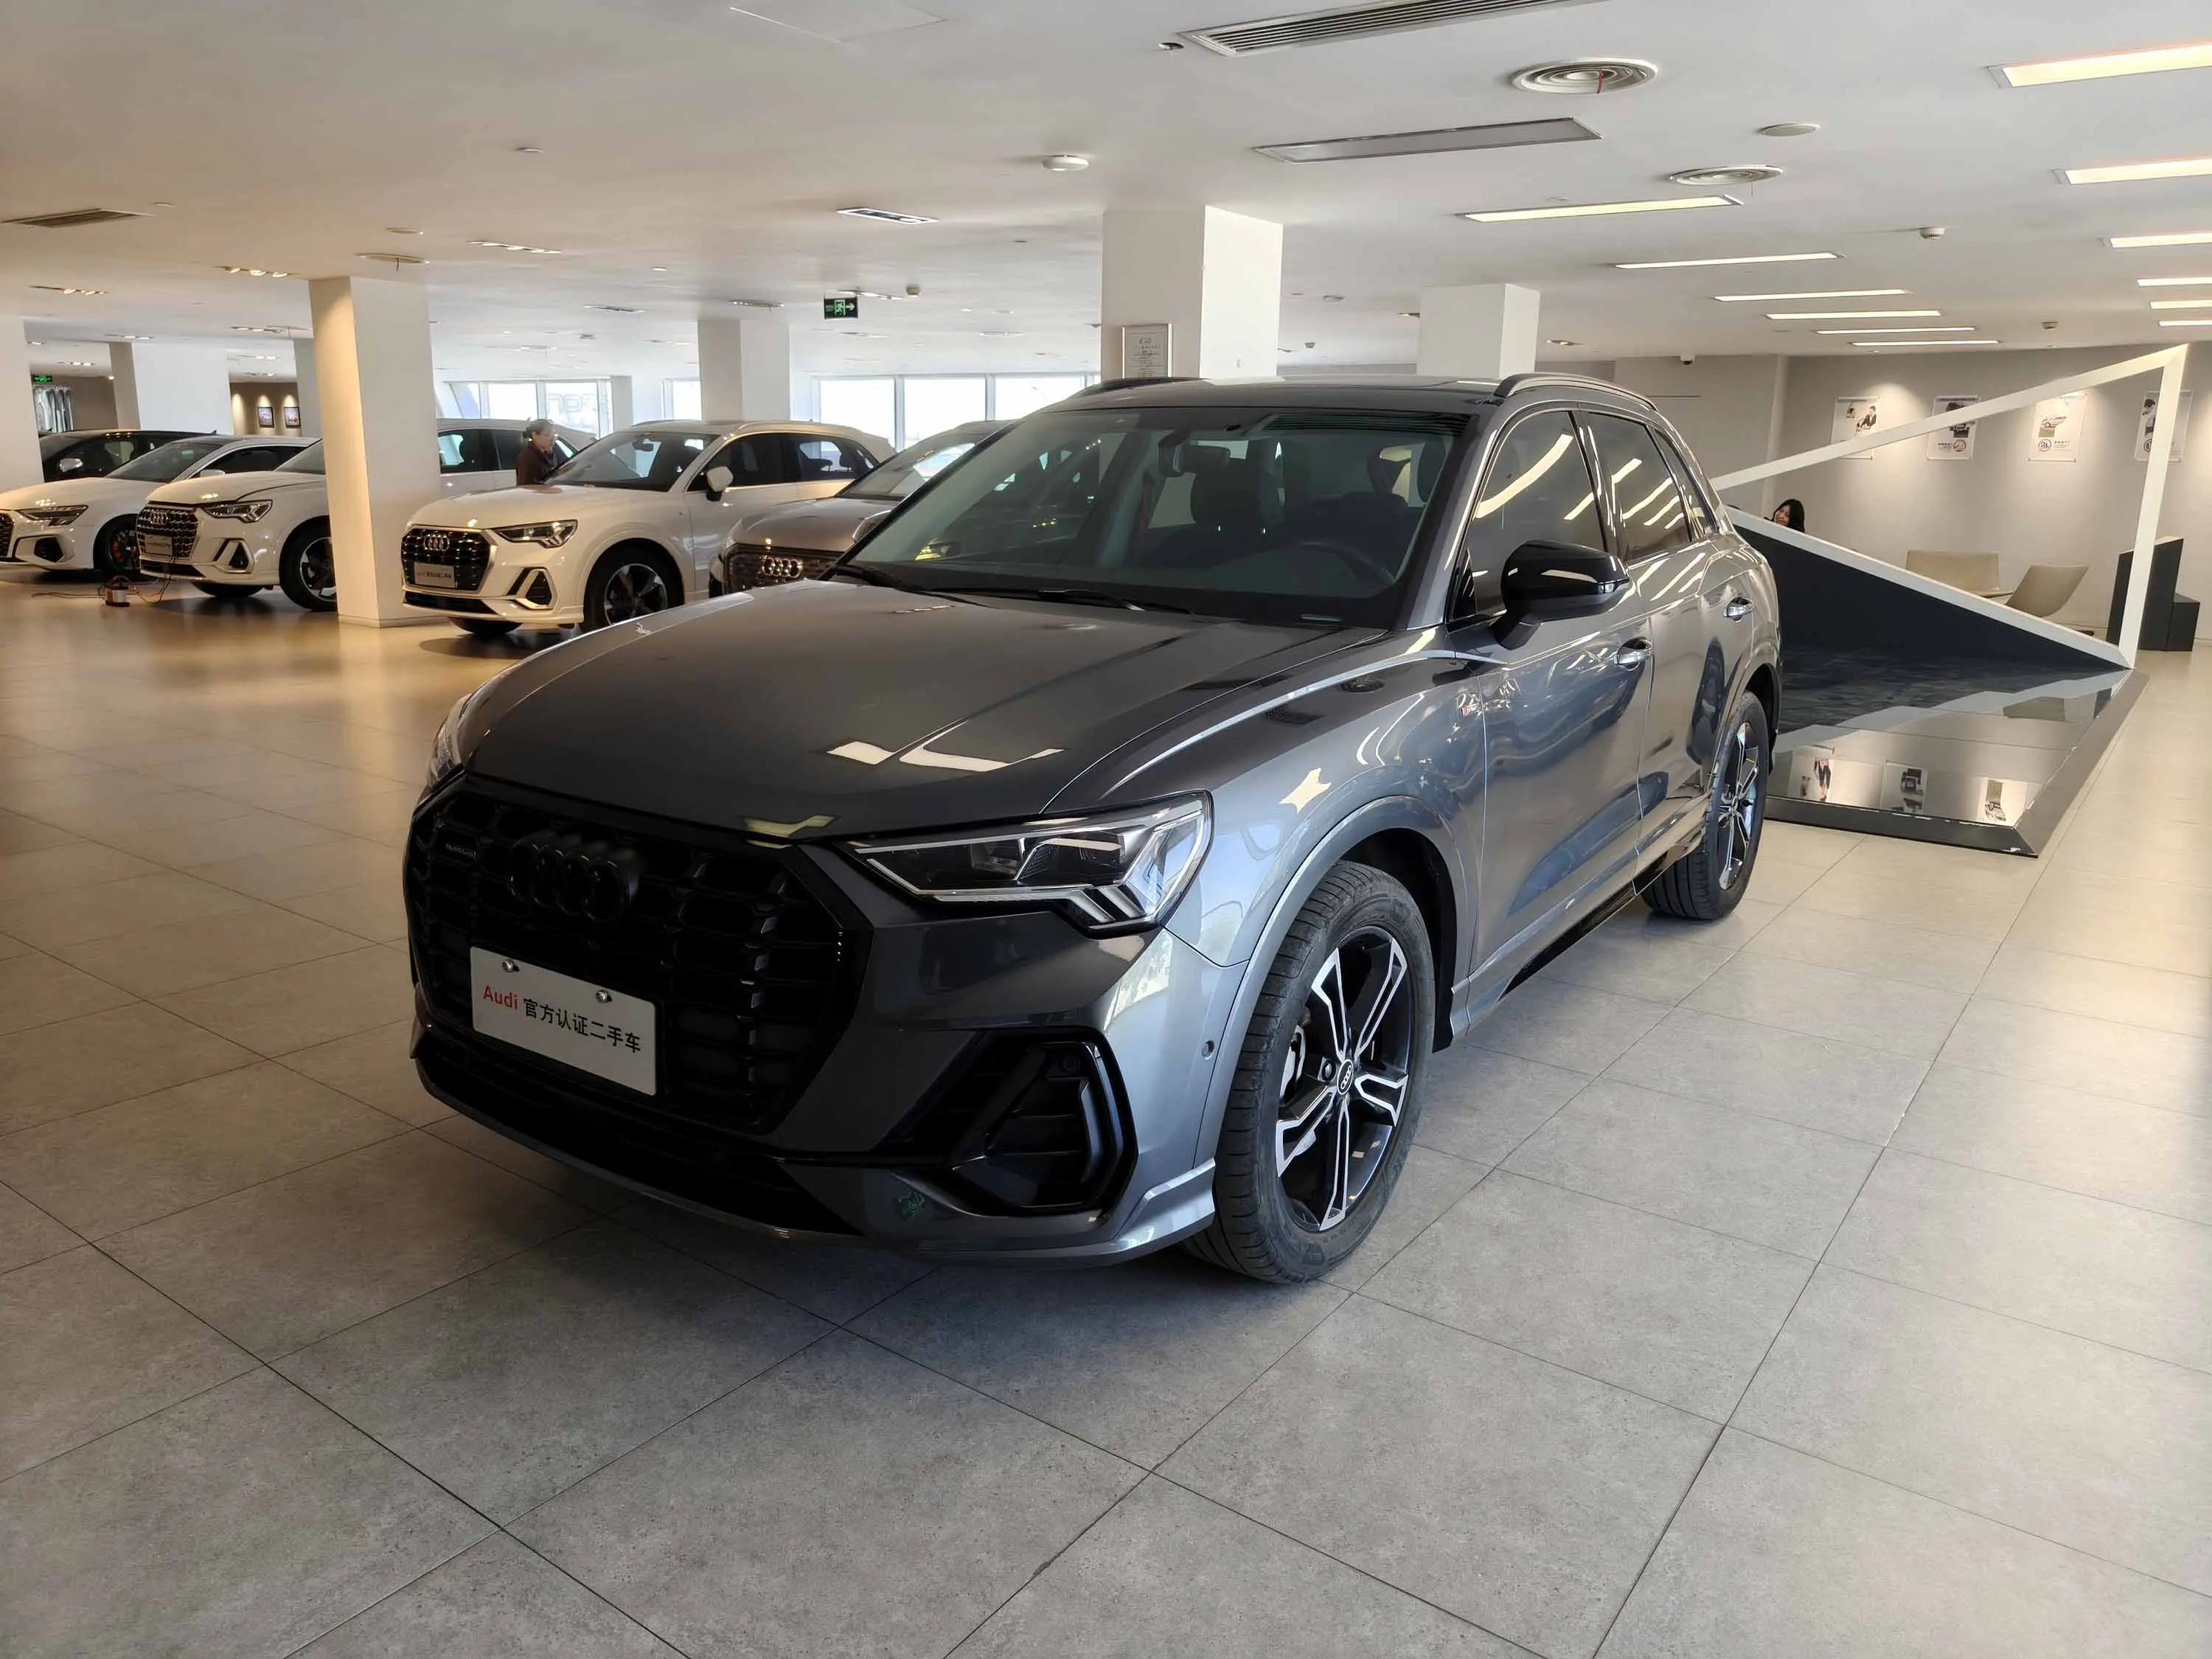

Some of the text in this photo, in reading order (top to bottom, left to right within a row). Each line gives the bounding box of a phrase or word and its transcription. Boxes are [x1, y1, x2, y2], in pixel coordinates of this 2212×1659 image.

[483, 985, 641, 1053] Audi 官方认证二手车
